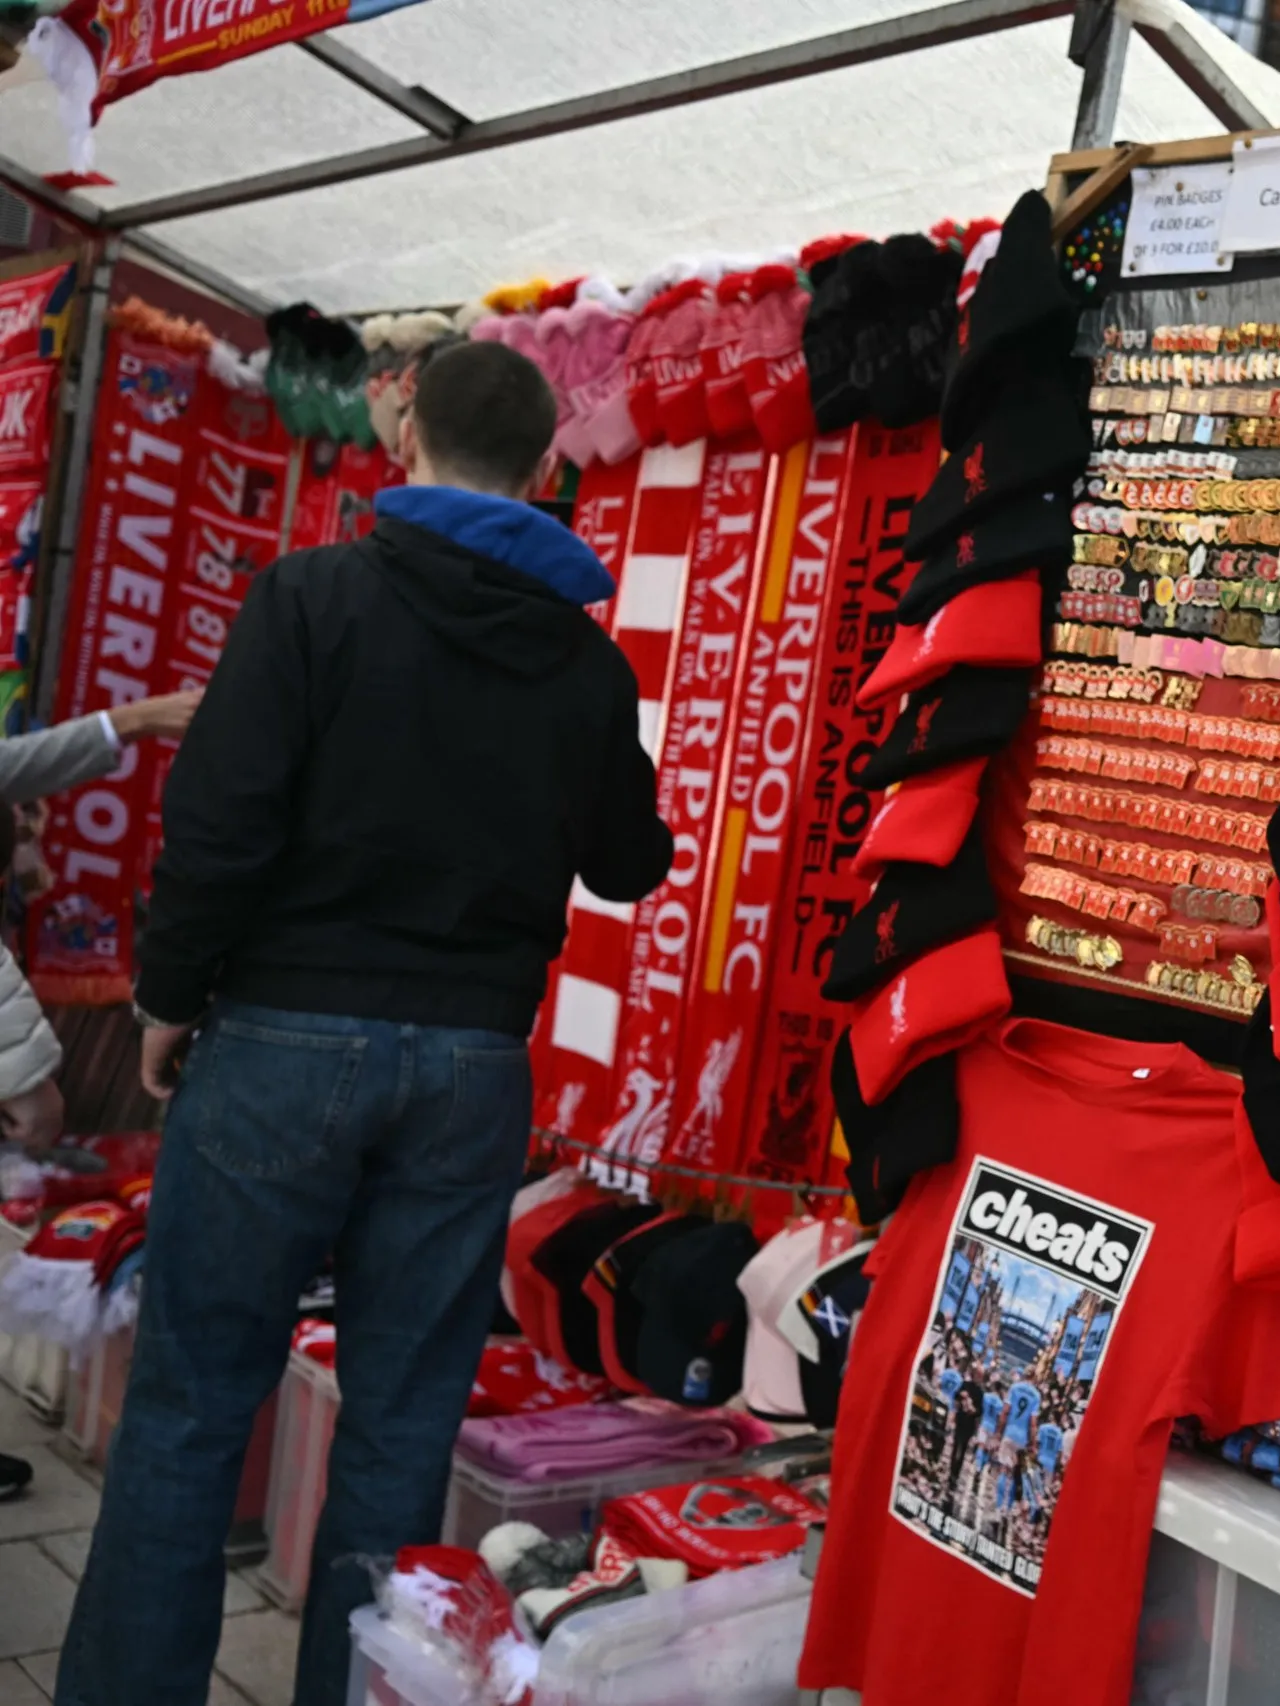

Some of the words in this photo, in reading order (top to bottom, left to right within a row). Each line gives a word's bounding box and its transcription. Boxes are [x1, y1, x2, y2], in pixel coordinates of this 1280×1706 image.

[217, 8, 297, 50] SUNDAY
[1176, 188, 1223, 205] BADGES
[836, 555, 867, 654] THIS
[742, 438, 847, 876] LIVERPOOL
[828, 667, 854, 708] IS
[731, 629, 775, 802] ANFIELD
[723, 901, 770, 995] FC
[969, 1188, 1130, 1283] cheats
